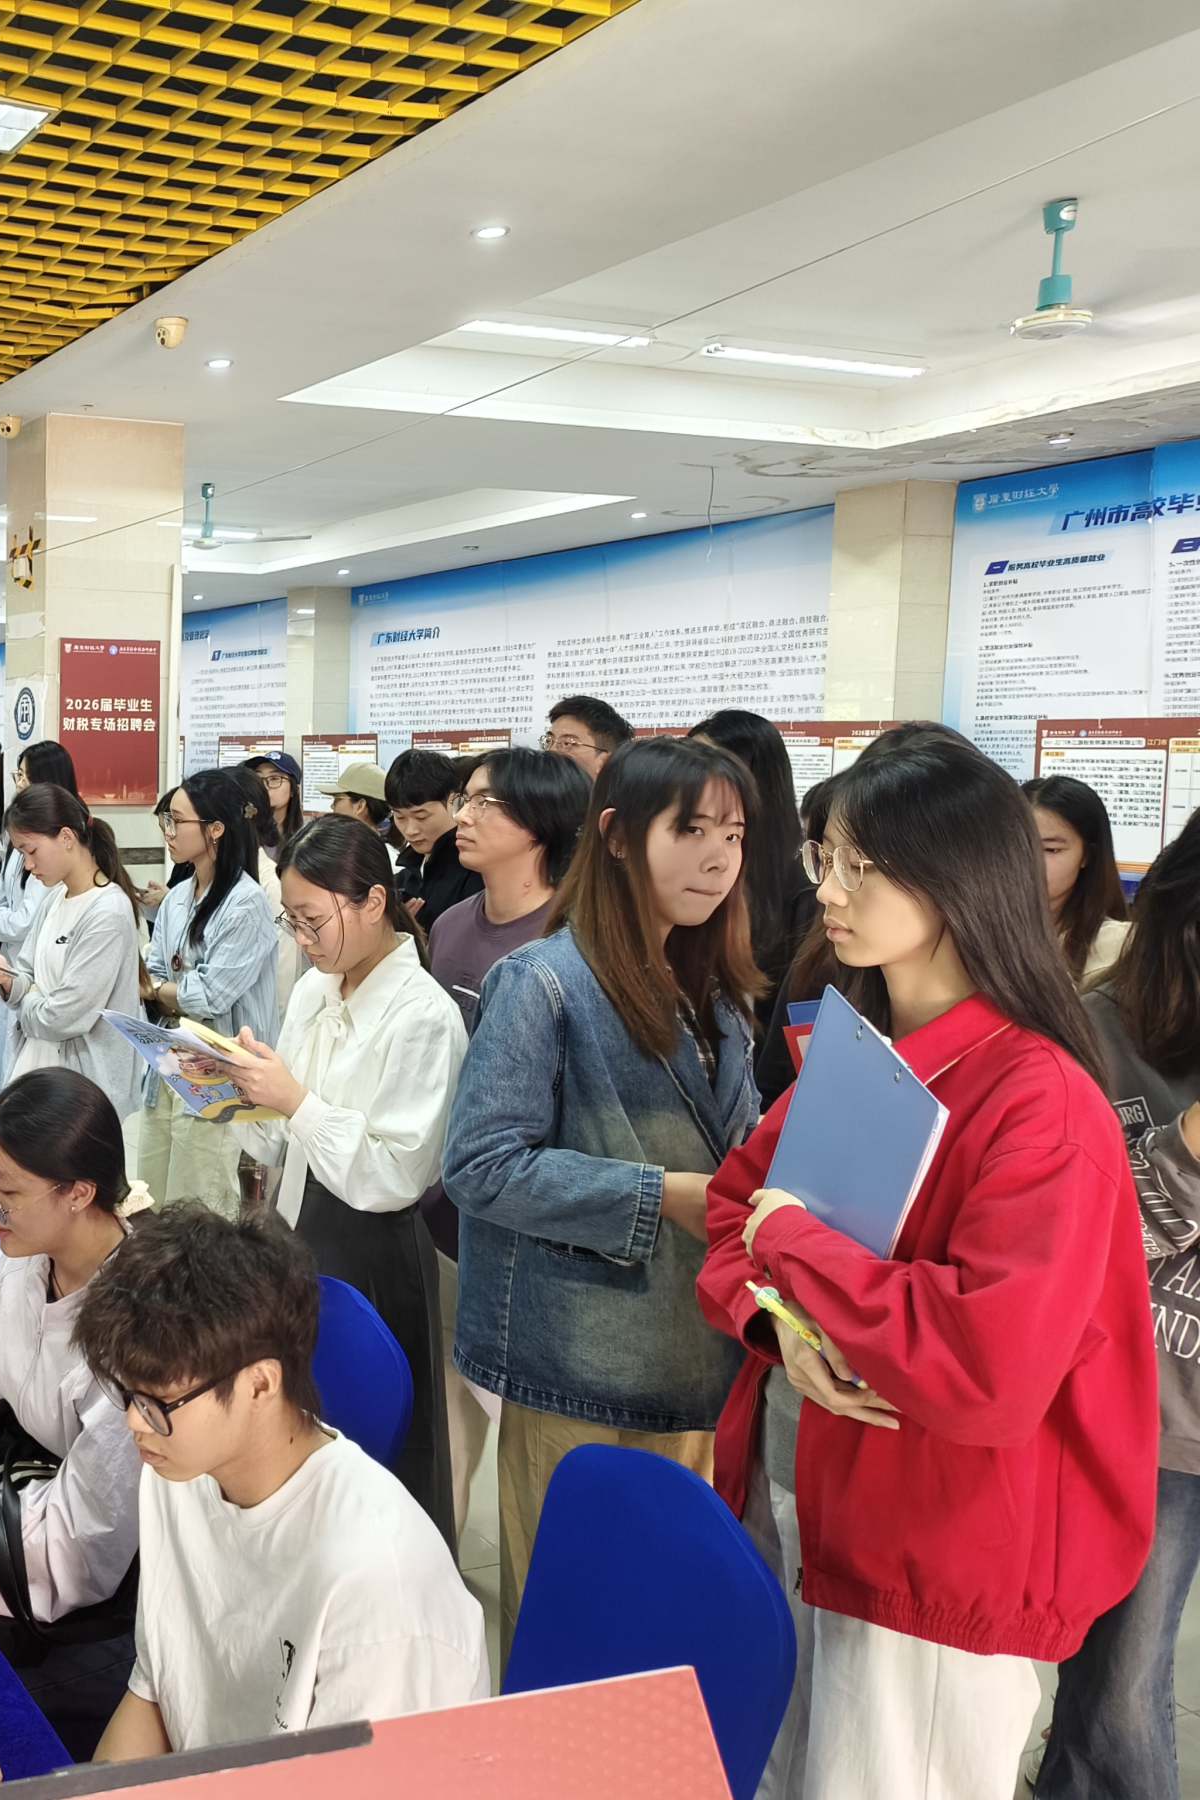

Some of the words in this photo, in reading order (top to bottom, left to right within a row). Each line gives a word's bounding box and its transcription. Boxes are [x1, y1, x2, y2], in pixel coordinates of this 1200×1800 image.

[377, 626, 440, 645] 广东财经大学简介
[66, 698, 153, 712] 2026届毕业生
[63, 717, 156, 732] 财税专场招聘会
